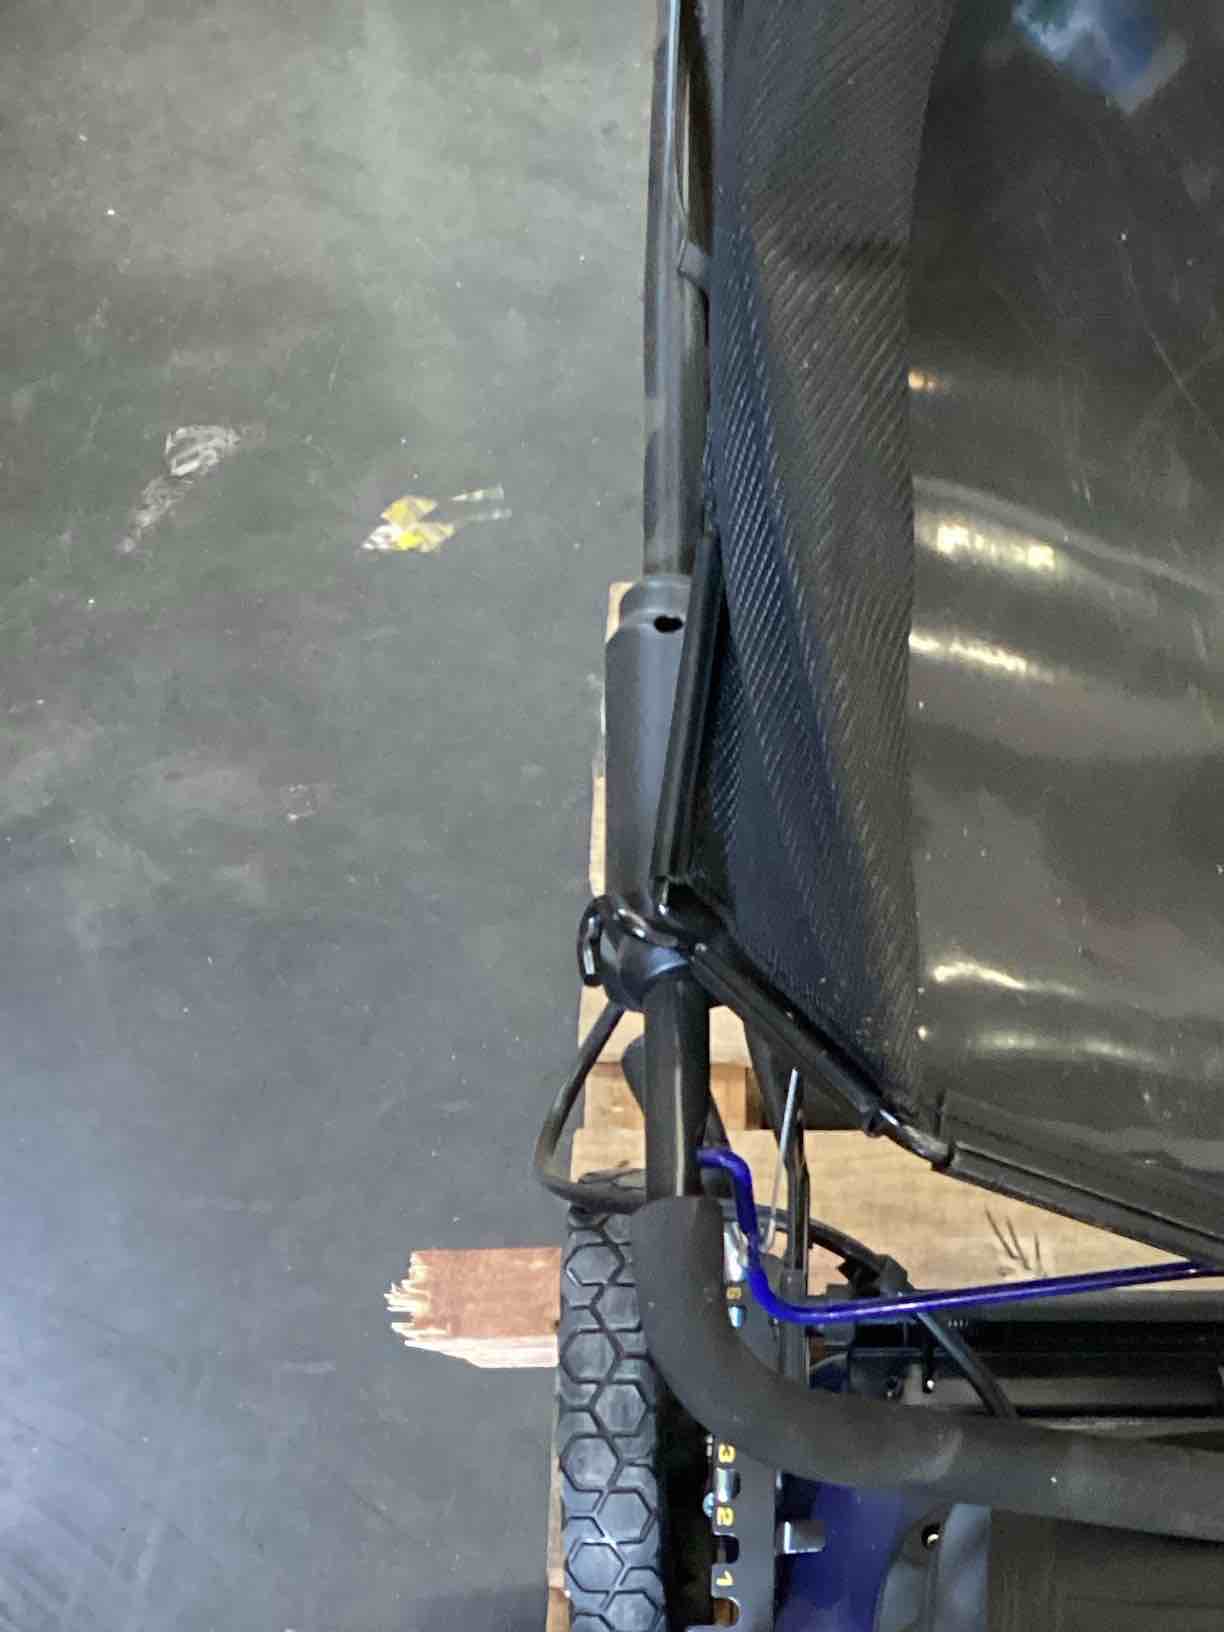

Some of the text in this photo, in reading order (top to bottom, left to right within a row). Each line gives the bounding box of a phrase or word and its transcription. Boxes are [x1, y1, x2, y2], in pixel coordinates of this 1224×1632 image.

[717, 1442, 736, 1464] 3
[716, 1505, 734, 1527] 2
[715, 1569, 734, 1587] 1
